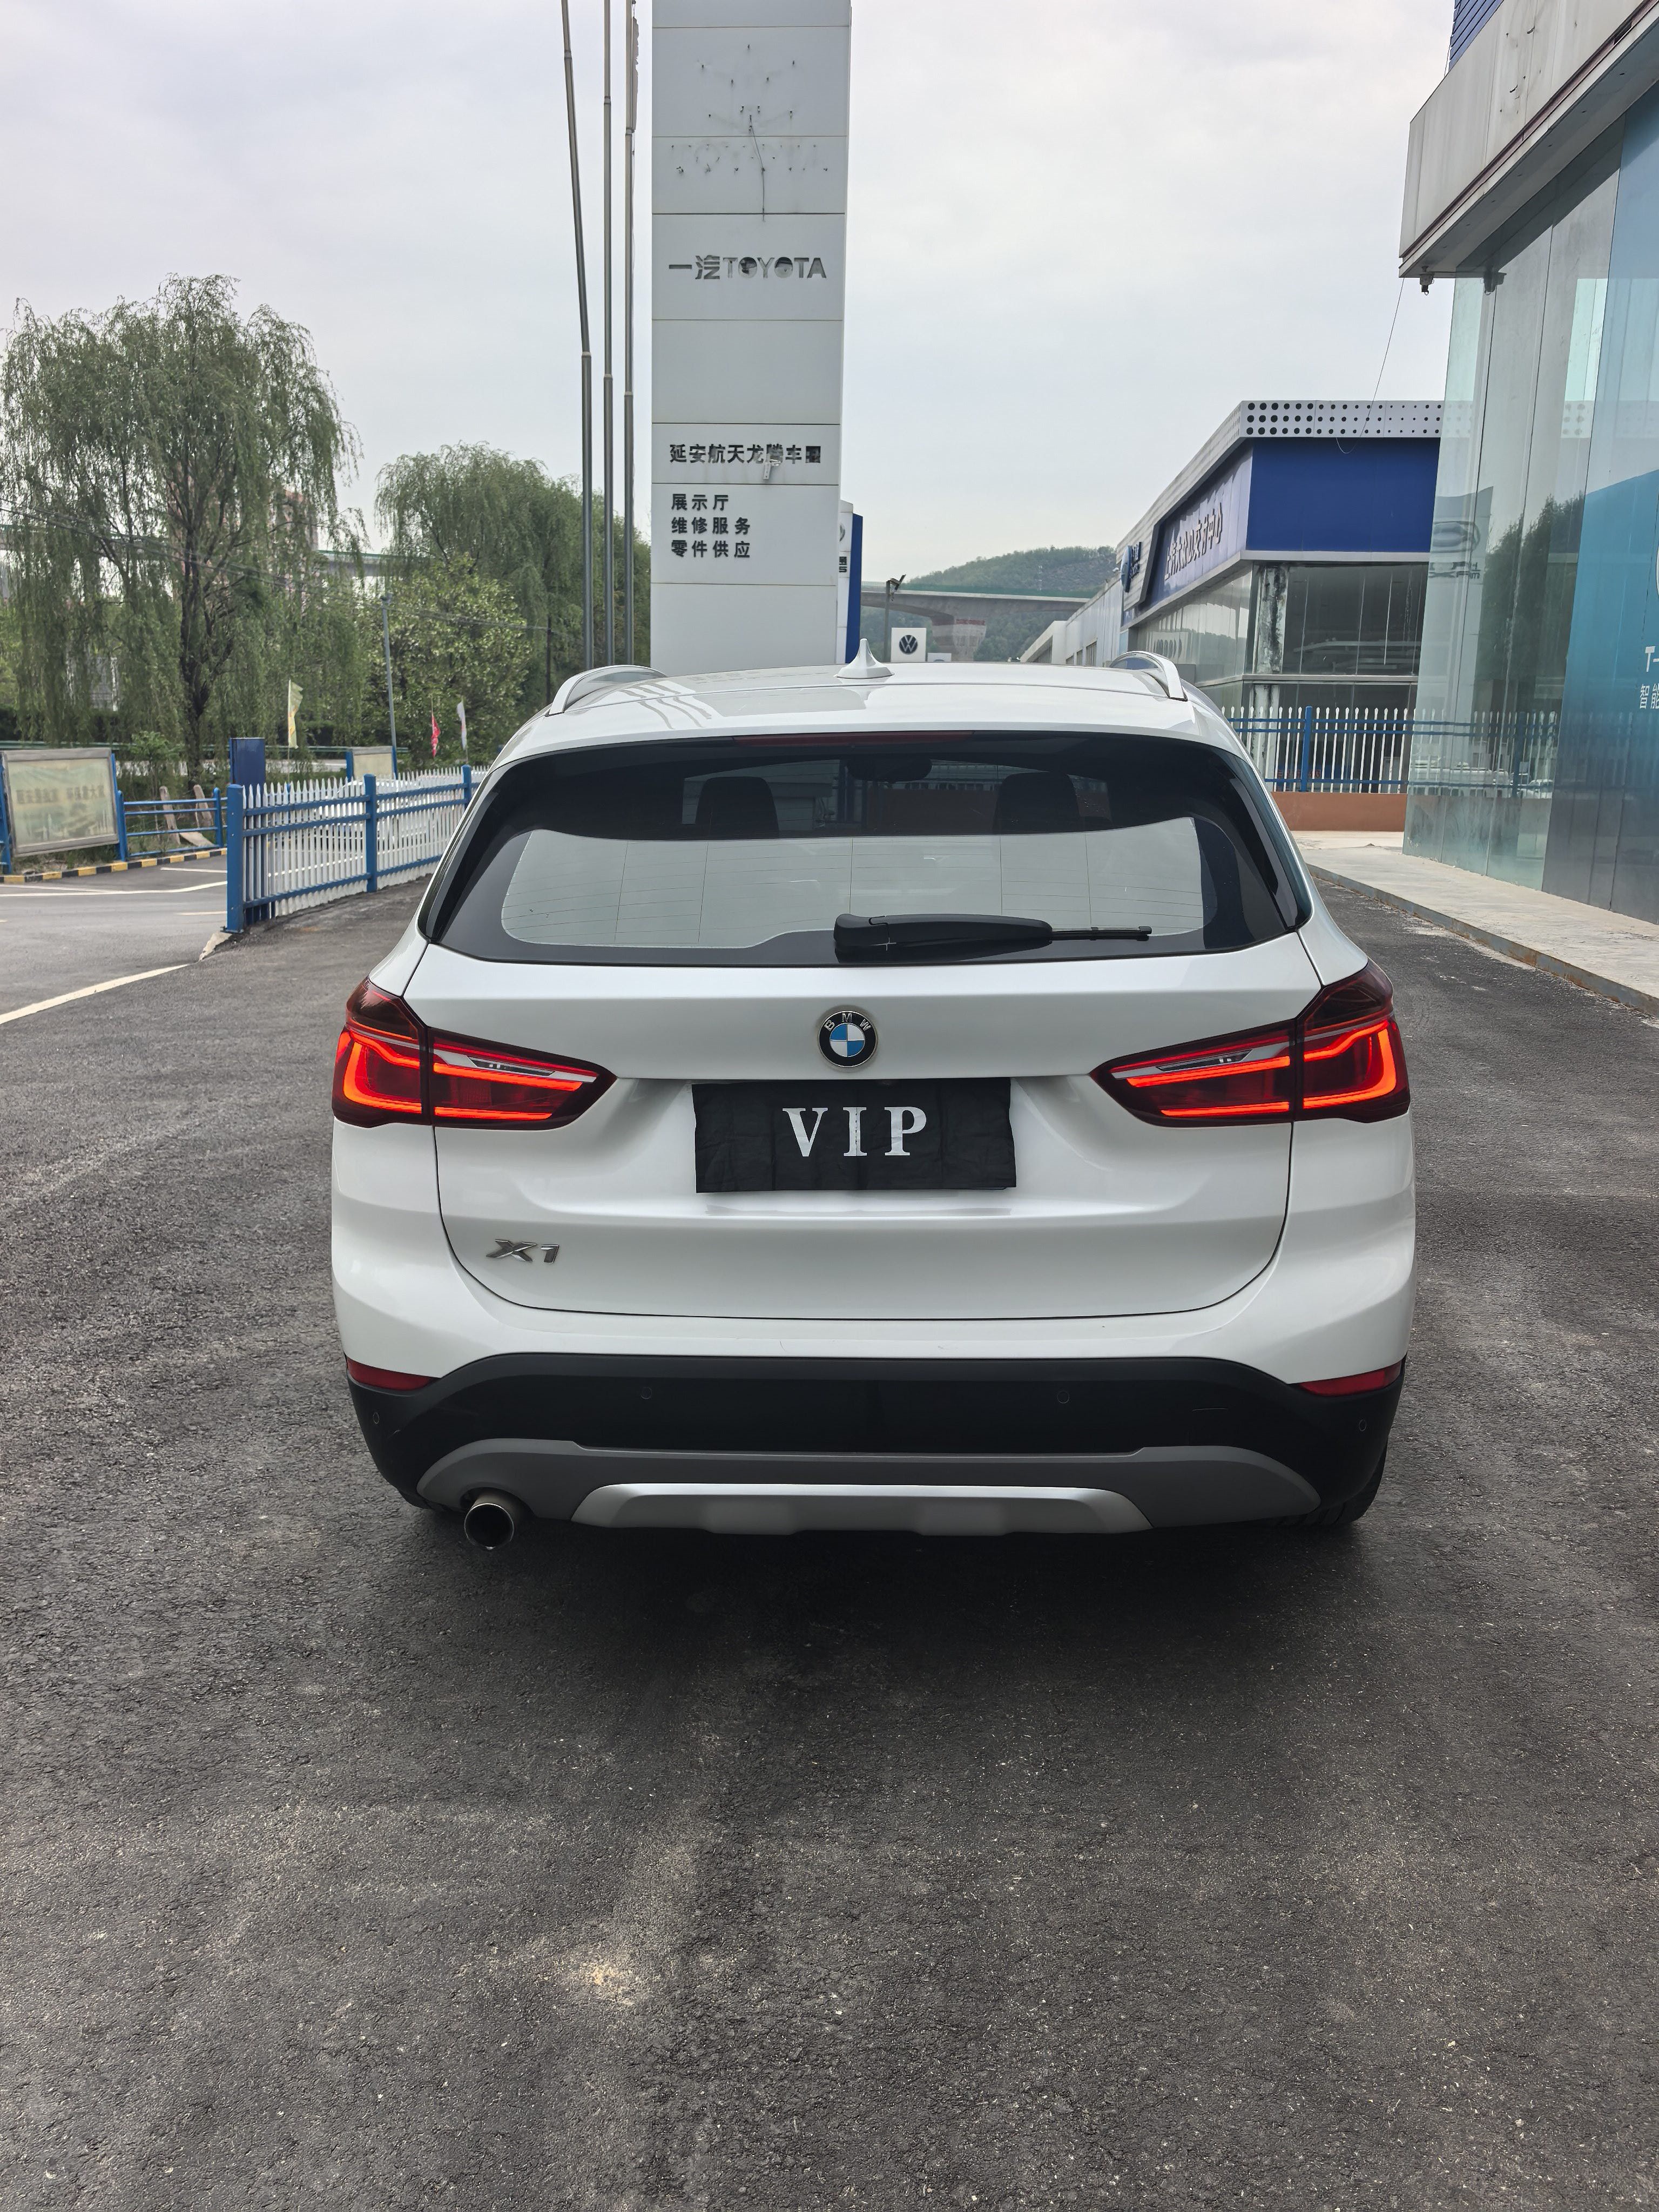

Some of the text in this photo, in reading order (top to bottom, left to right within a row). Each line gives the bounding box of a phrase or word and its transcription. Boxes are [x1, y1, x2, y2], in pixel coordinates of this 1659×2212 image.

[671, 494, 729, 511] 展示厅
[671, 517, 751, 535] 维修服务
[671, 539, 751, 558] 零件供应
[824, 1013, 871, 1031] BMW
[783, 1107, 927, 1157] VIP
[486, 1239, 559, 1264] X1
